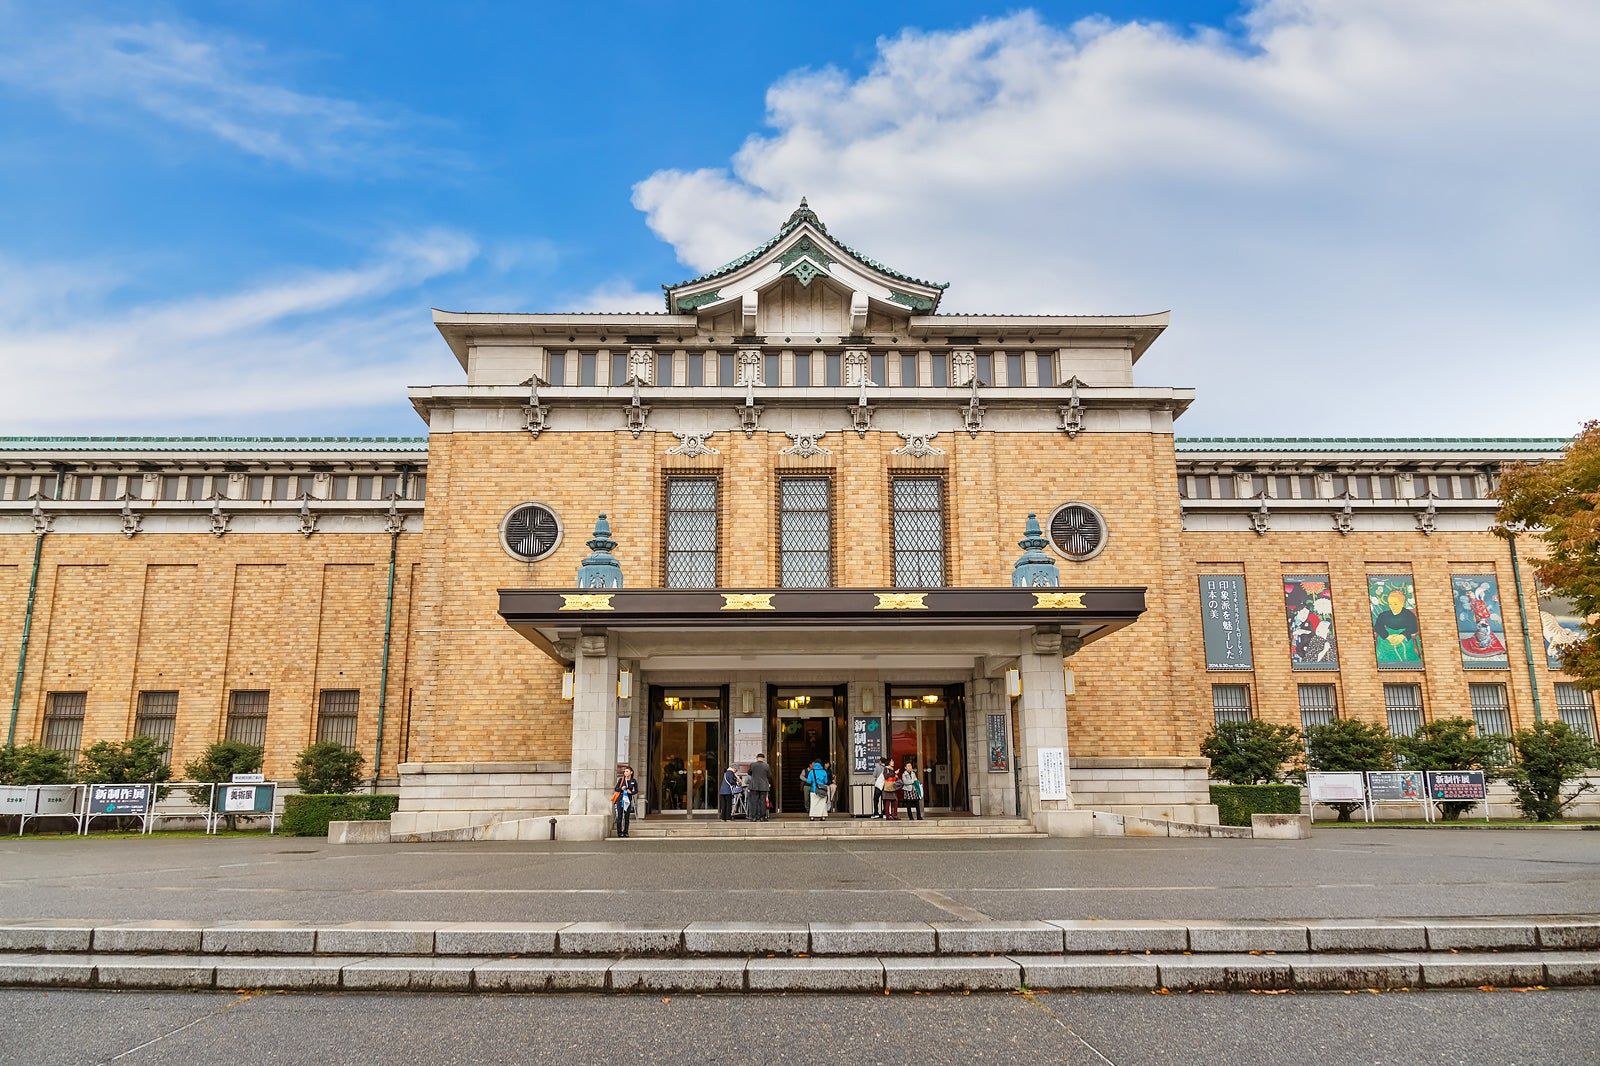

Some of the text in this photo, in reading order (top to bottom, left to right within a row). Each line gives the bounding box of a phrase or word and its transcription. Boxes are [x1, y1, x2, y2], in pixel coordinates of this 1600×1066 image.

[1208, 581, 1219, 619] 日本の美
[1219, 581, 1235, 660] 印象派を魅了した
[854, 719, 867, 771] 新制作展
[95, 788, 145, 800] 新制作展
[1435, 775, 1470, 784] 新制作展
